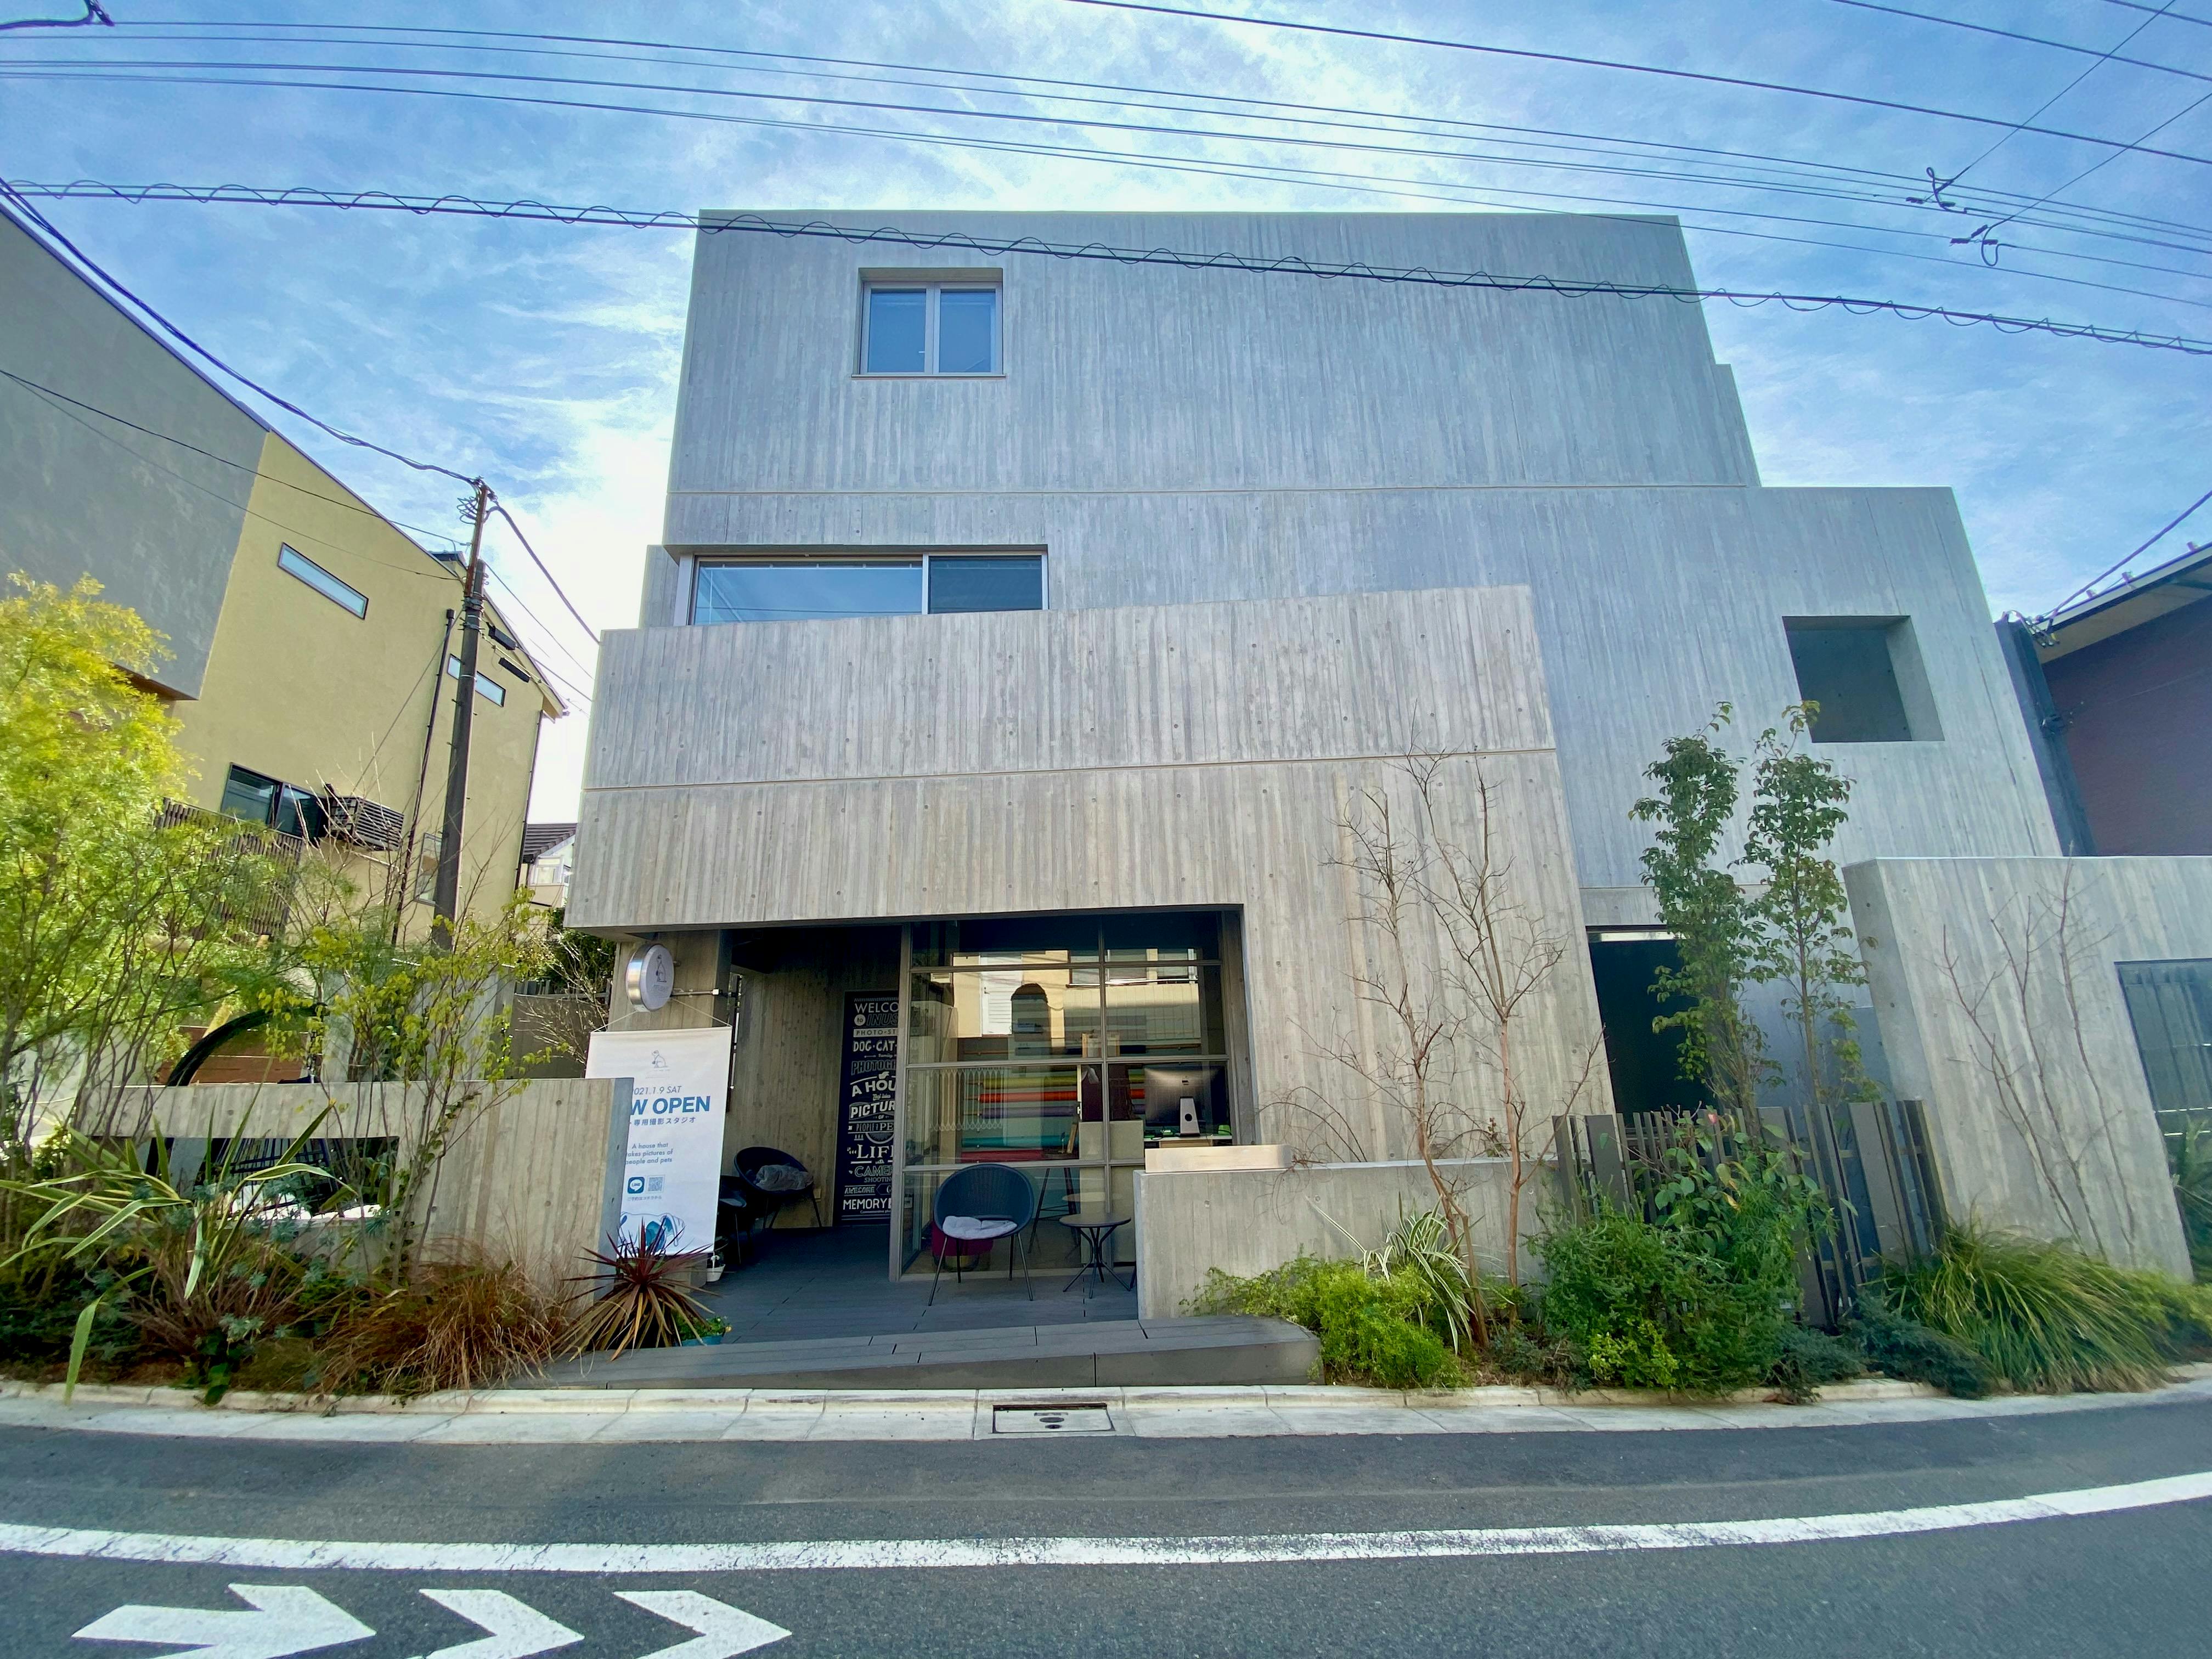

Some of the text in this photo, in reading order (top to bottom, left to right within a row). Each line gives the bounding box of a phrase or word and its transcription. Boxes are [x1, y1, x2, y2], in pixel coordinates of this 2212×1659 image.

[851, 1085, 862, 1097] A
[652, 1096, 710, 1114] OPEN
[850, 1101, 895, 1119] PICTUR
[629, 1117, 696, 1126] 専用撮影スタジオ
